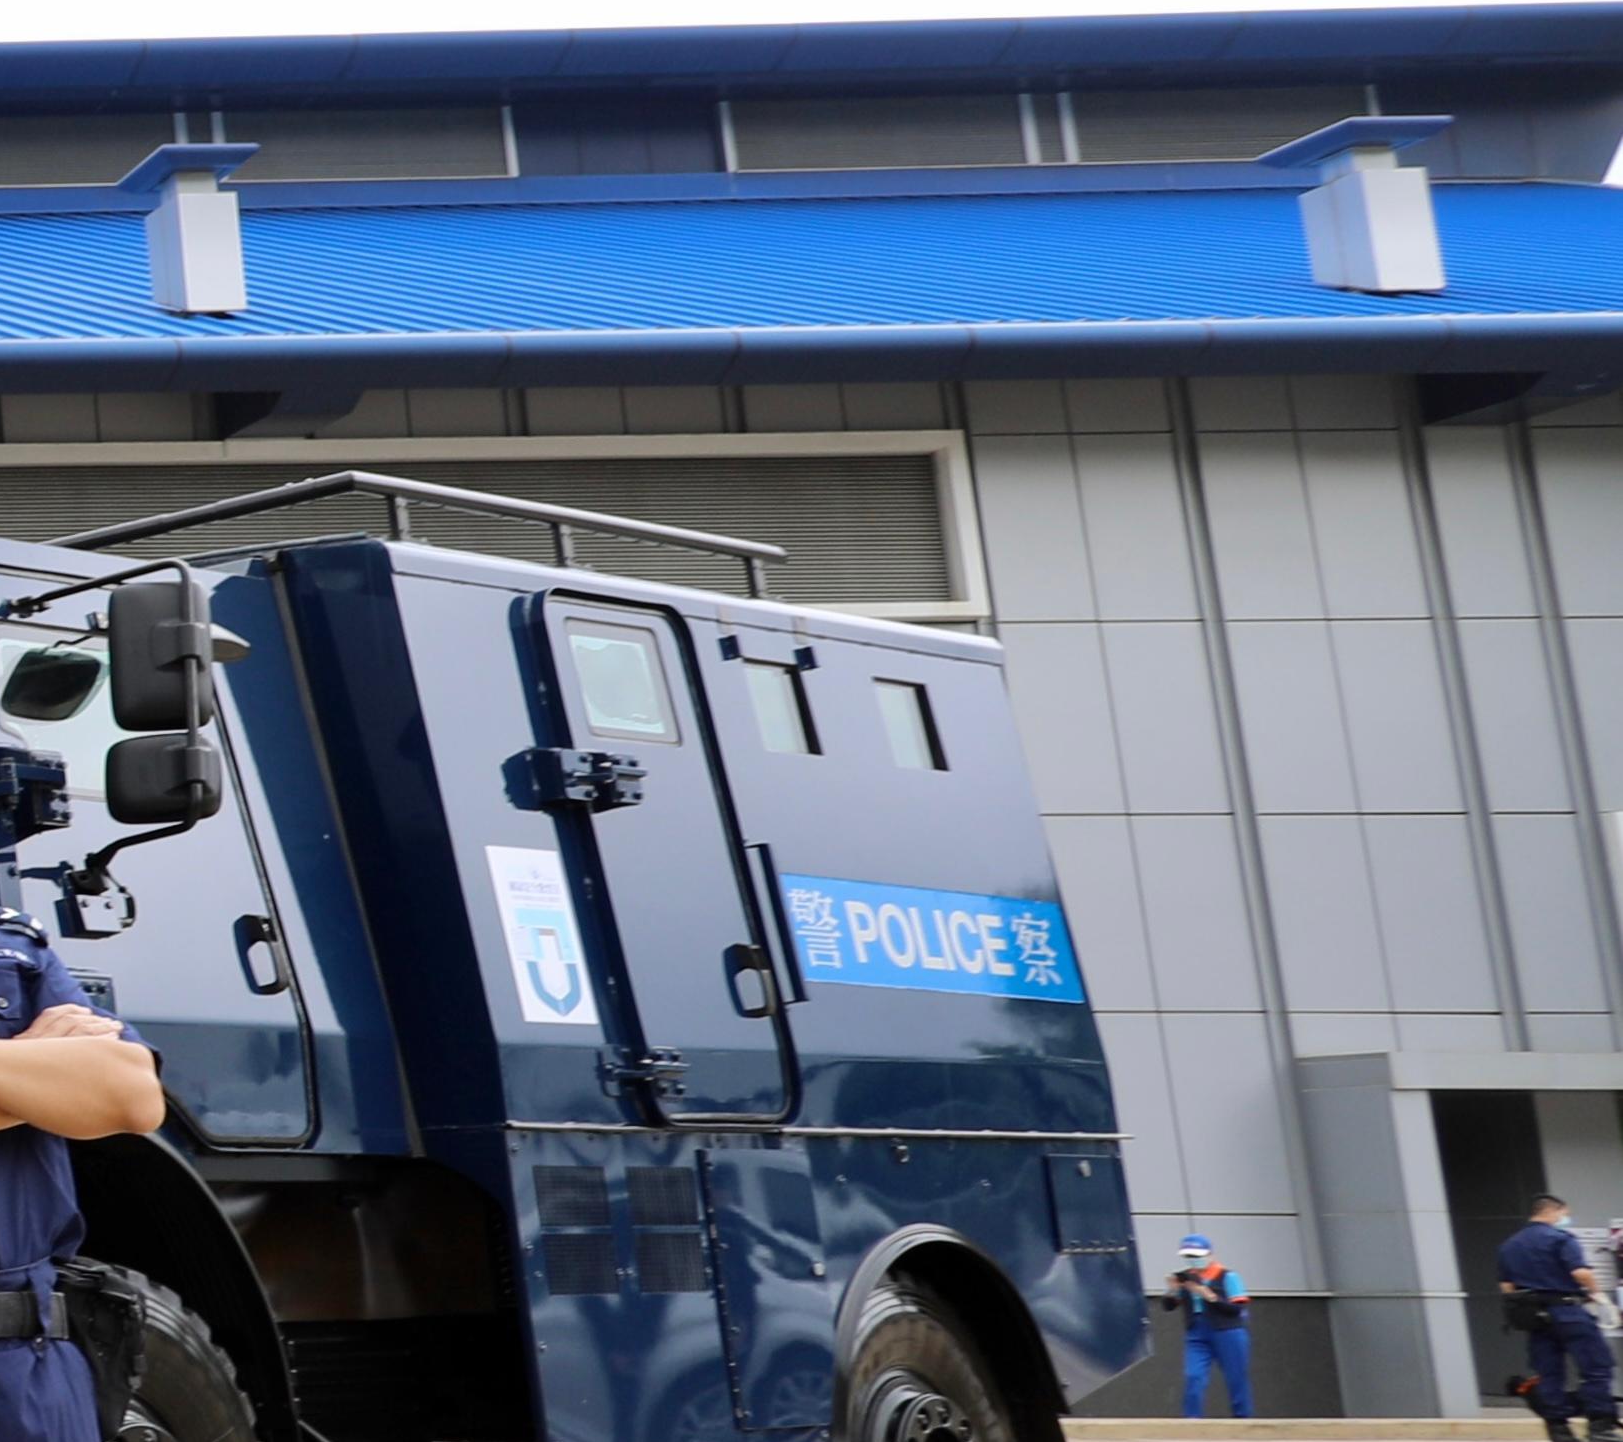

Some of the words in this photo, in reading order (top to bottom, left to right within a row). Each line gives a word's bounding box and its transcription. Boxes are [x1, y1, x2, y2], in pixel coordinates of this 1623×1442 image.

[787, 888, 843, 969] 警
[844, 900, 1017, 977] POLICE
[1010, 912, 1063, 986] 察
